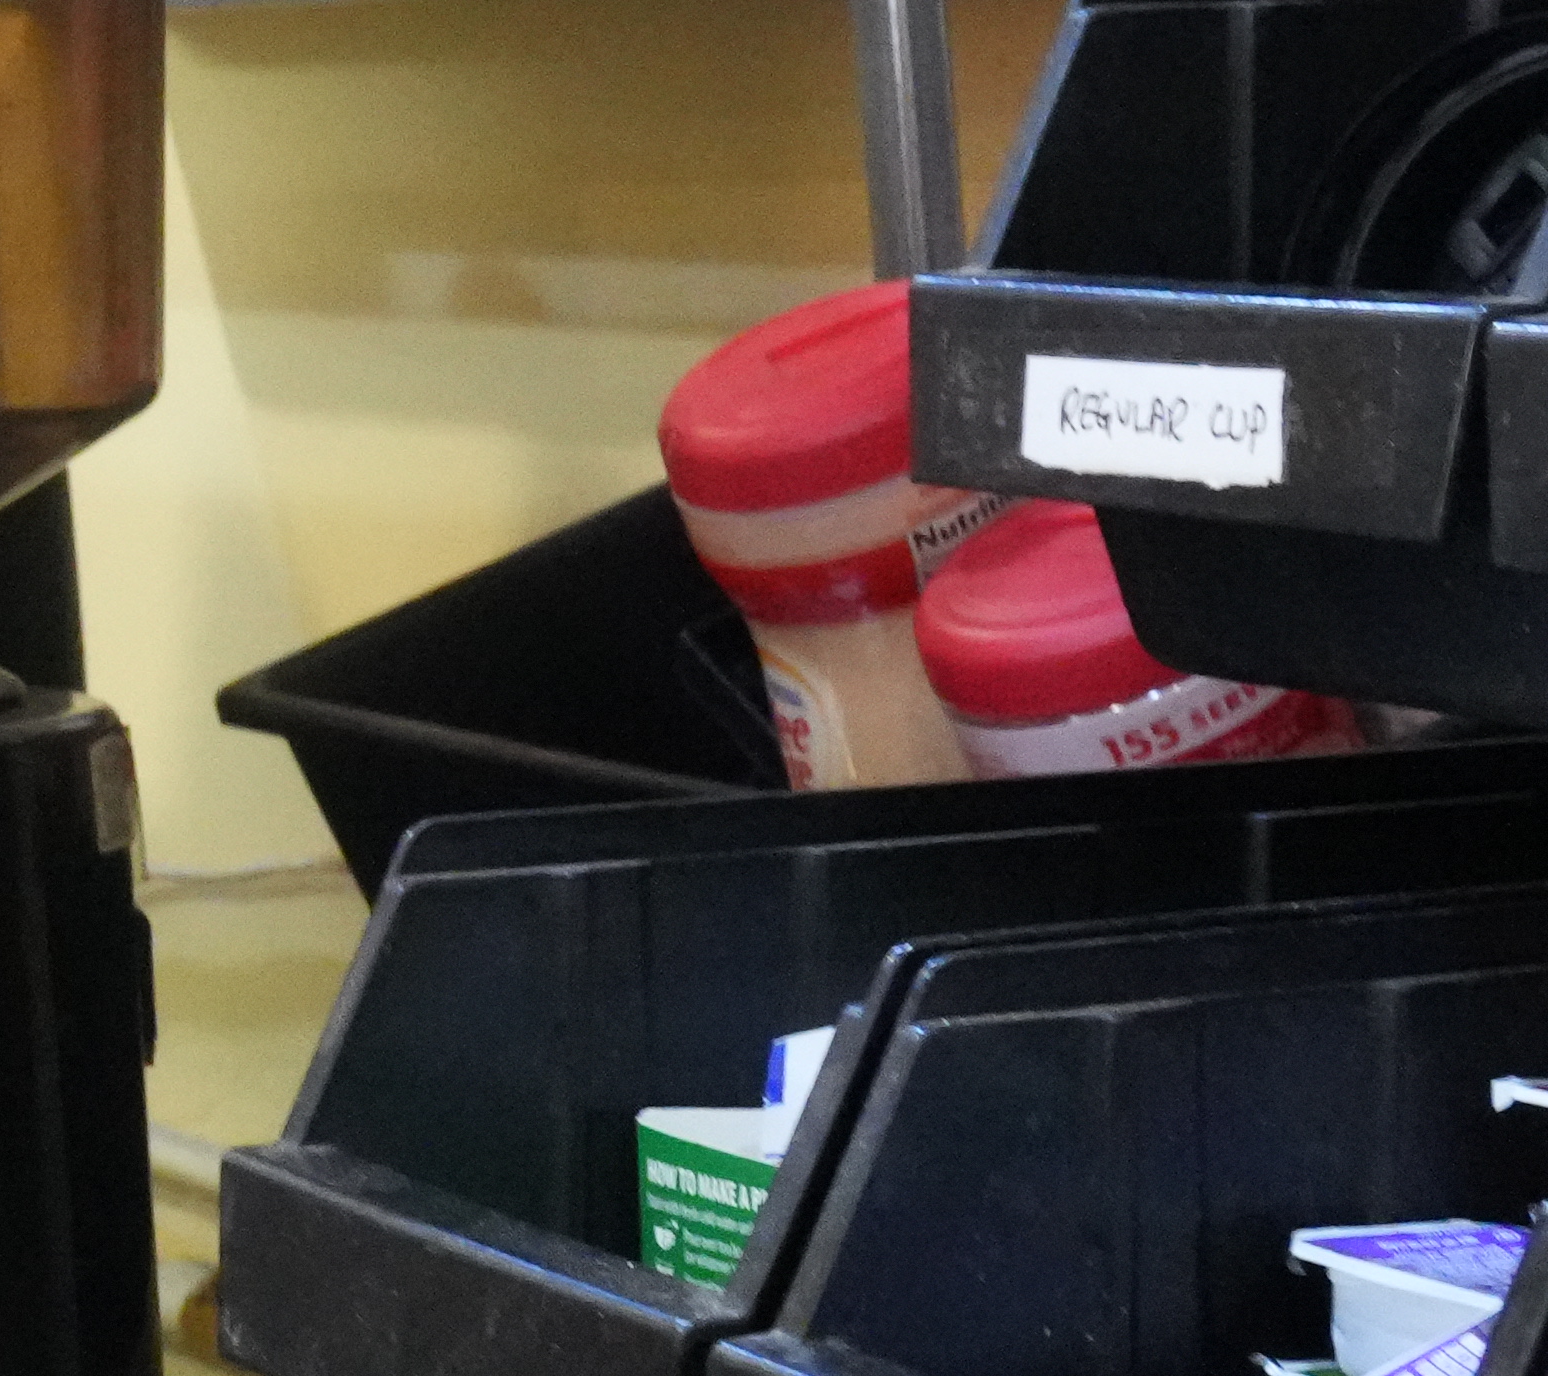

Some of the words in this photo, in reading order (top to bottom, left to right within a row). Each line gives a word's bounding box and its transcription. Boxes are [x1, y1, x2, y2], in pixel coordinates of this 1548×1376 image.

[1060, 387, 1189, 442] REGULAR
[1209, 401, 1268, 455] CUP
[1099, 718, 1180, 767] 155
[678, 1167, 697, 1197] TO
[697, 1172, 738, 1209] MAKE
